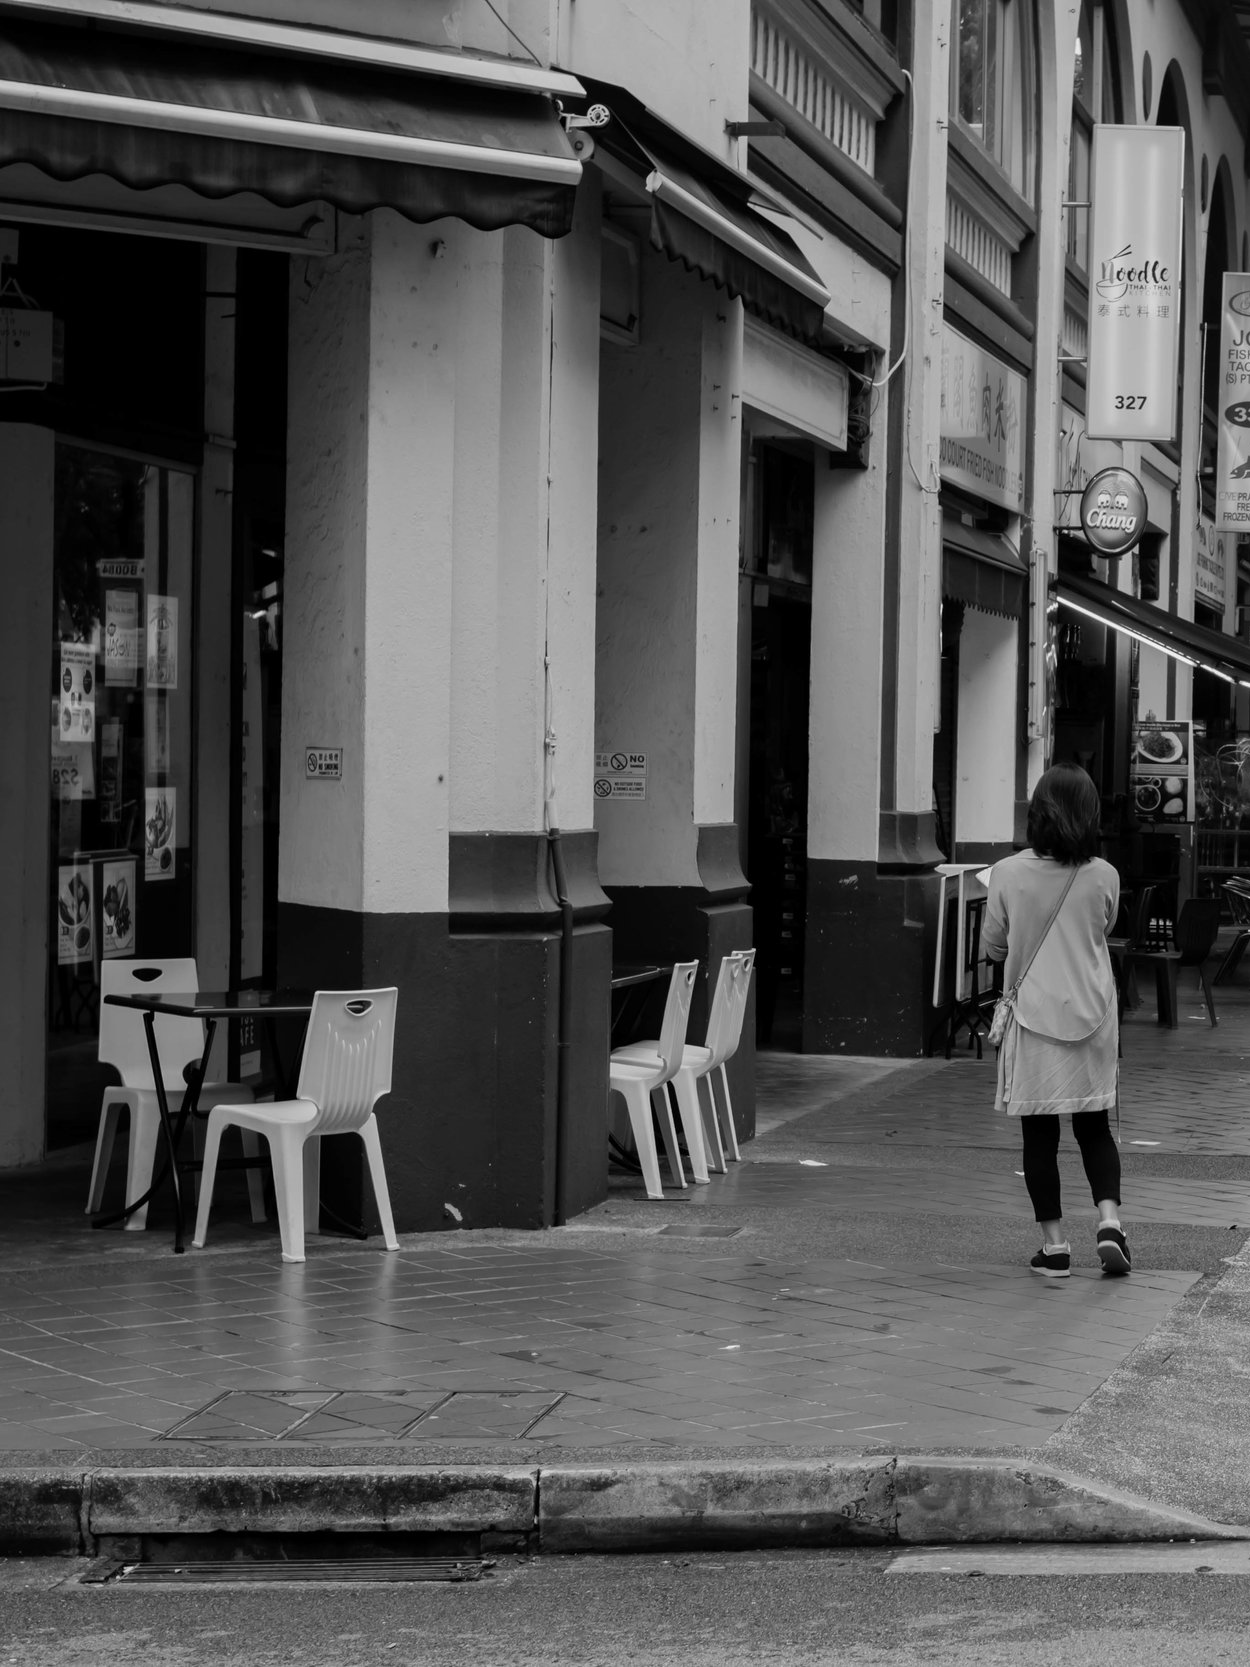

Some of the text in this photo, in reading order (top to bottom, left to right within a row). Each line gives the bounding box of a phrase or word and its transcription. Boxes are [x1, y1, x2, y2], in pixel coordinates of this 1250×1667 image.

[1225, 372, 1237, 385] (S)
[1114, 395, 1148, 411] 327
[1086, 508, 1137, 534] Chang
[1223, 512, 1250, 522] FROZEN
[630, 755, 645, 763] NO
